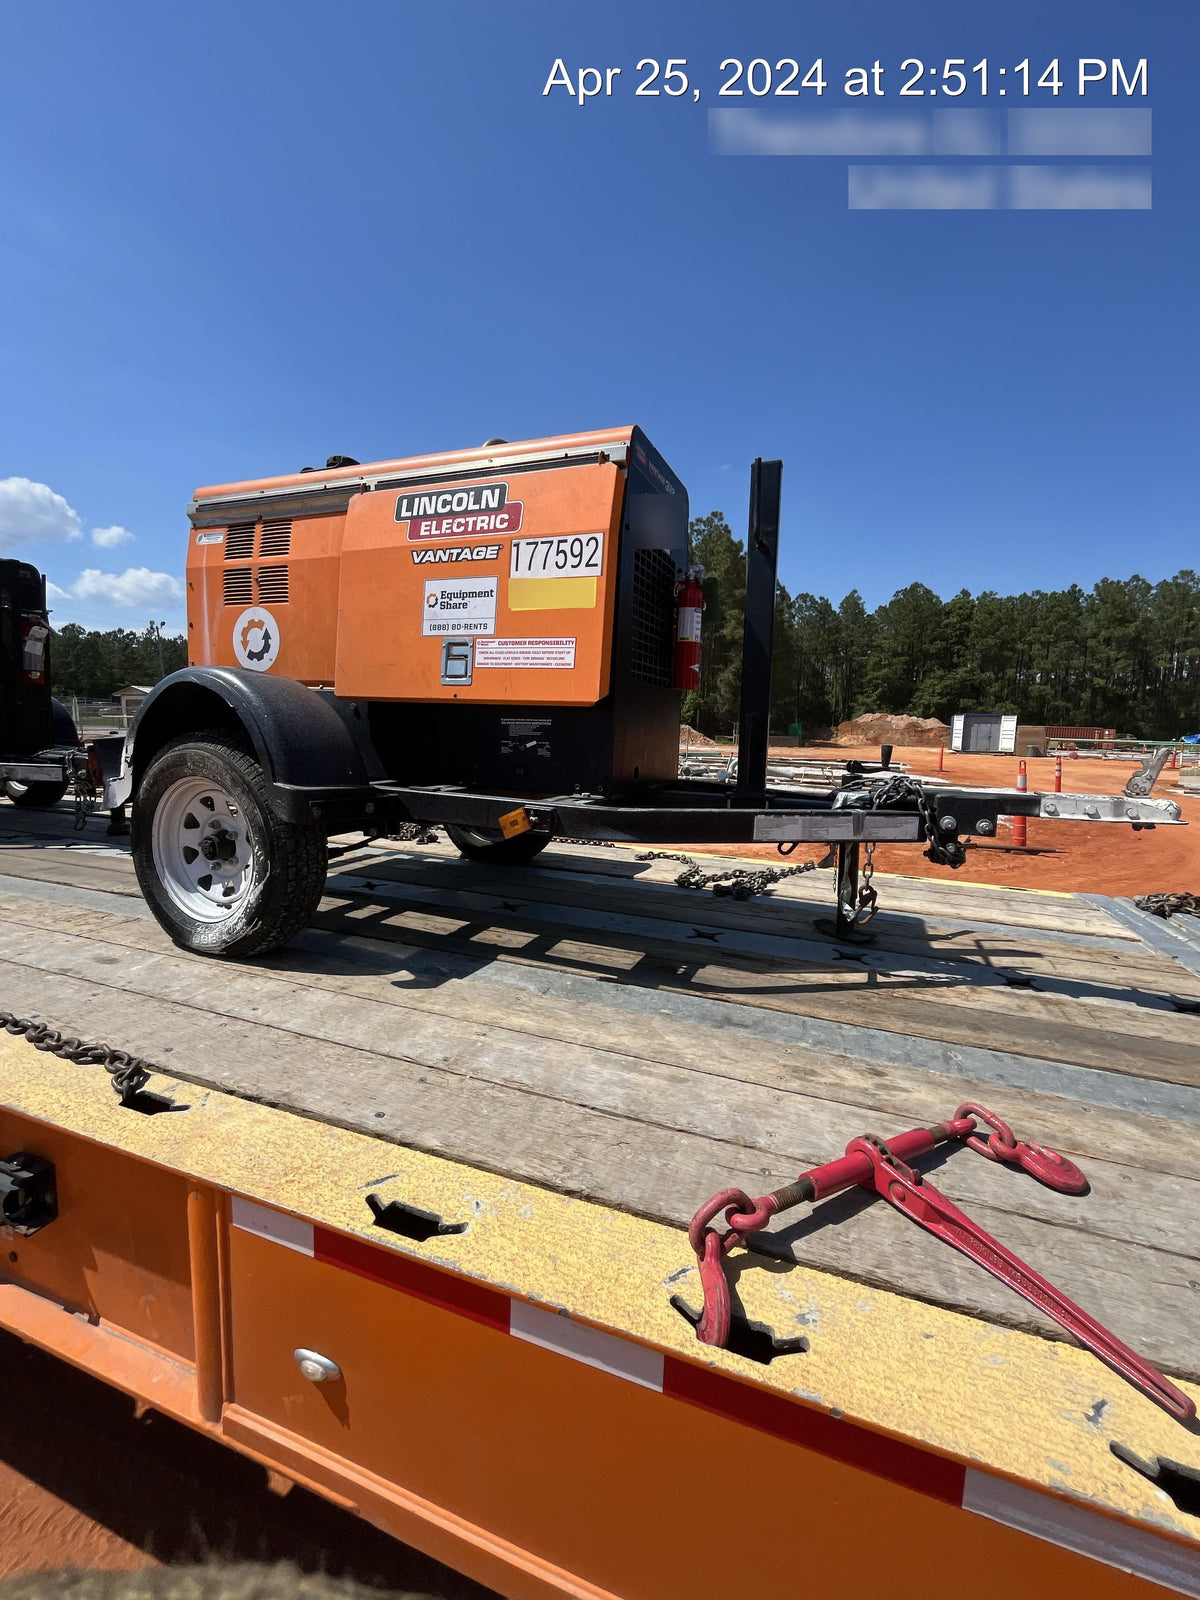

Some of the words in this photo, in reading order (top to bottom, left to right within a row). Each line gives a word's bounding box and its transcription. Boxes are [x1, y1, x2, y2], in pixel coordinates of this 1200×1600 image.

[400, 488, 500, 517] LINCOLN
[420, 513, 510, 536] ELECTRIC
[411, 545, 500, 564] VANTAGE
[512, 536, 599, 572] 177592
[440, 589, 495, 601] Equipment
[439, 601, 468, 610] Share
[429, 623, 449, 632] (888)
